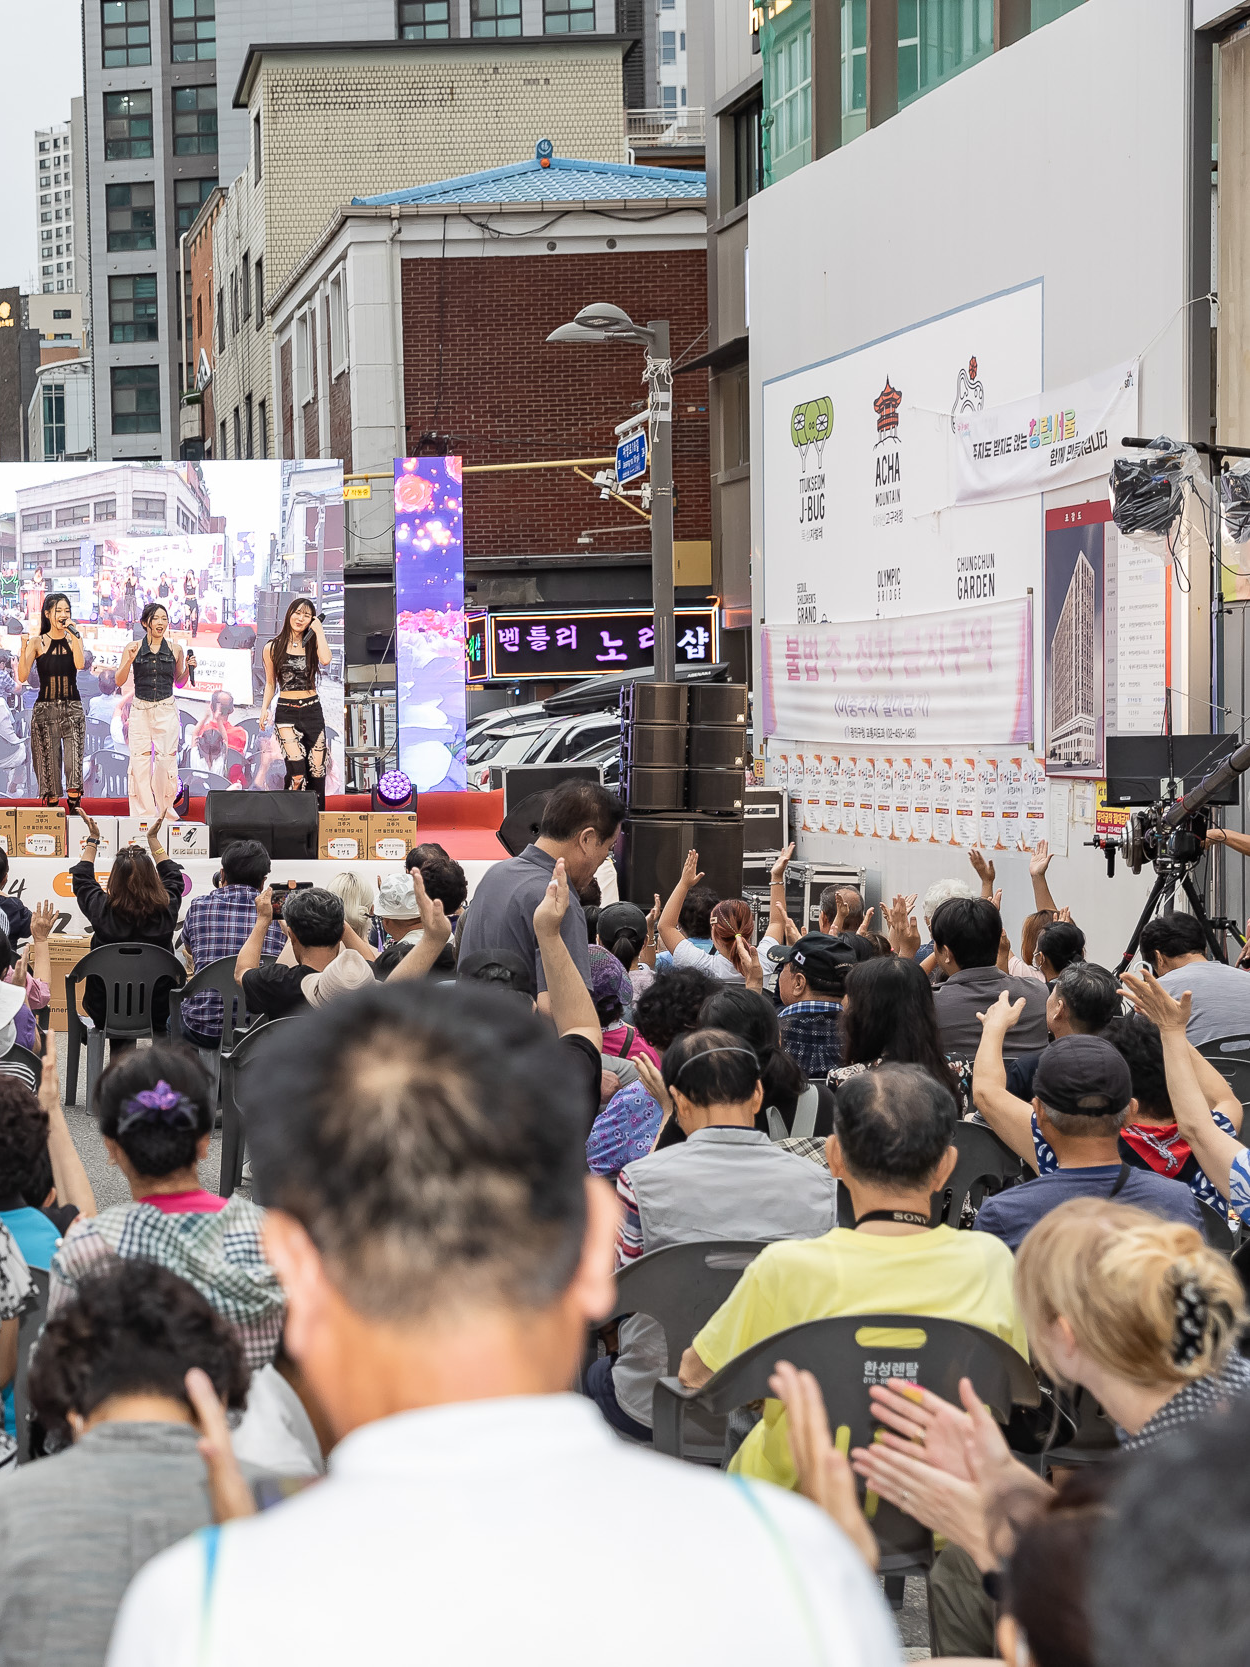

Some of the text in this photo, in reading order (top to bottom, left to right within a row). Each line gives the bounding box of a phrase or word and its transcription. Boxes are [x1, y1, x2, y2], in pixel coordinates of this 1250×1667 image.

[875, 452, 901, 487] ACHA
[799, 493, 826, 524] J-BUG
[957, 553, 995, 572] CHUNGCHUN
[957, 573, 995, 600] GARDEN
[893, 1212, 926, 1225] SONY
[864, 1361, 919, 1377] 한성렌탈
